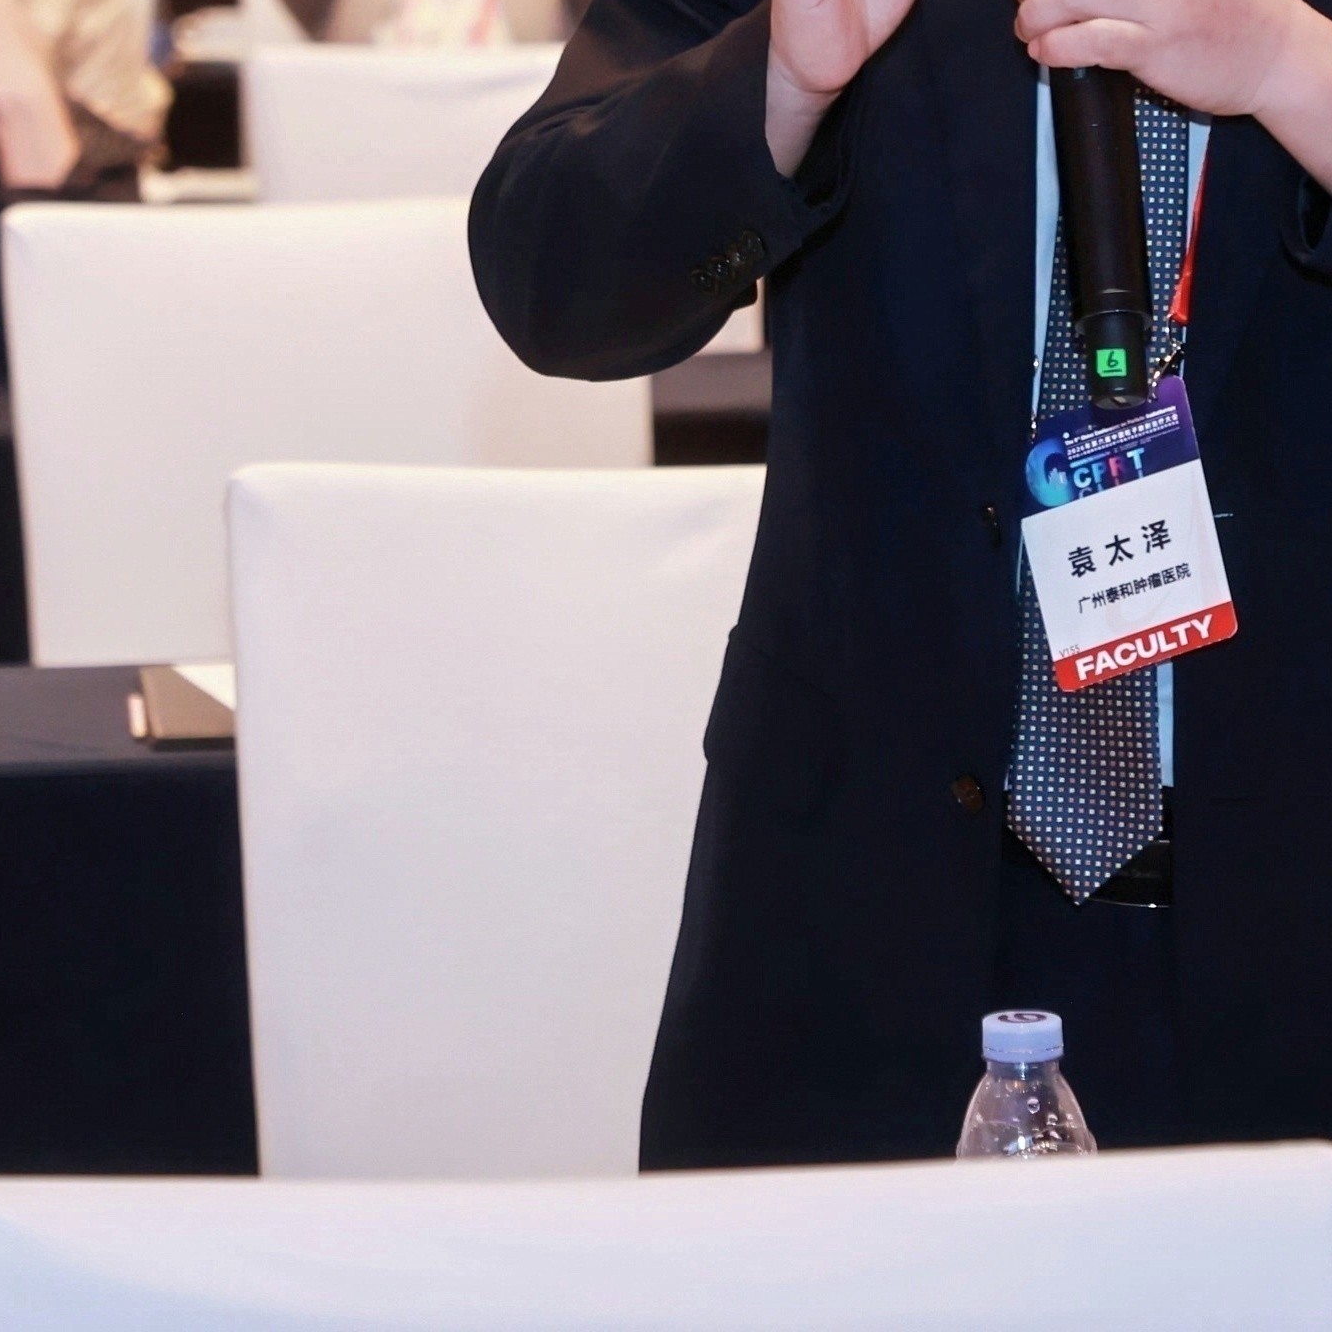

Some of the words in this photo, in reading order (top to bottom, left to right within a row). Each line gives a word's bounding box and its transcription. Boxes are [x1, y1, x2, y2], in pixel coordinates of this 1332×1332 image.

[1106, 350, 1119, 368] 6
[1068, 520, 1171, 578] 袁太泽
[1078, 563, 1191, 614] 广州泰和肿瘤医院
[1075, 614, 1213, 681] FACULTY
